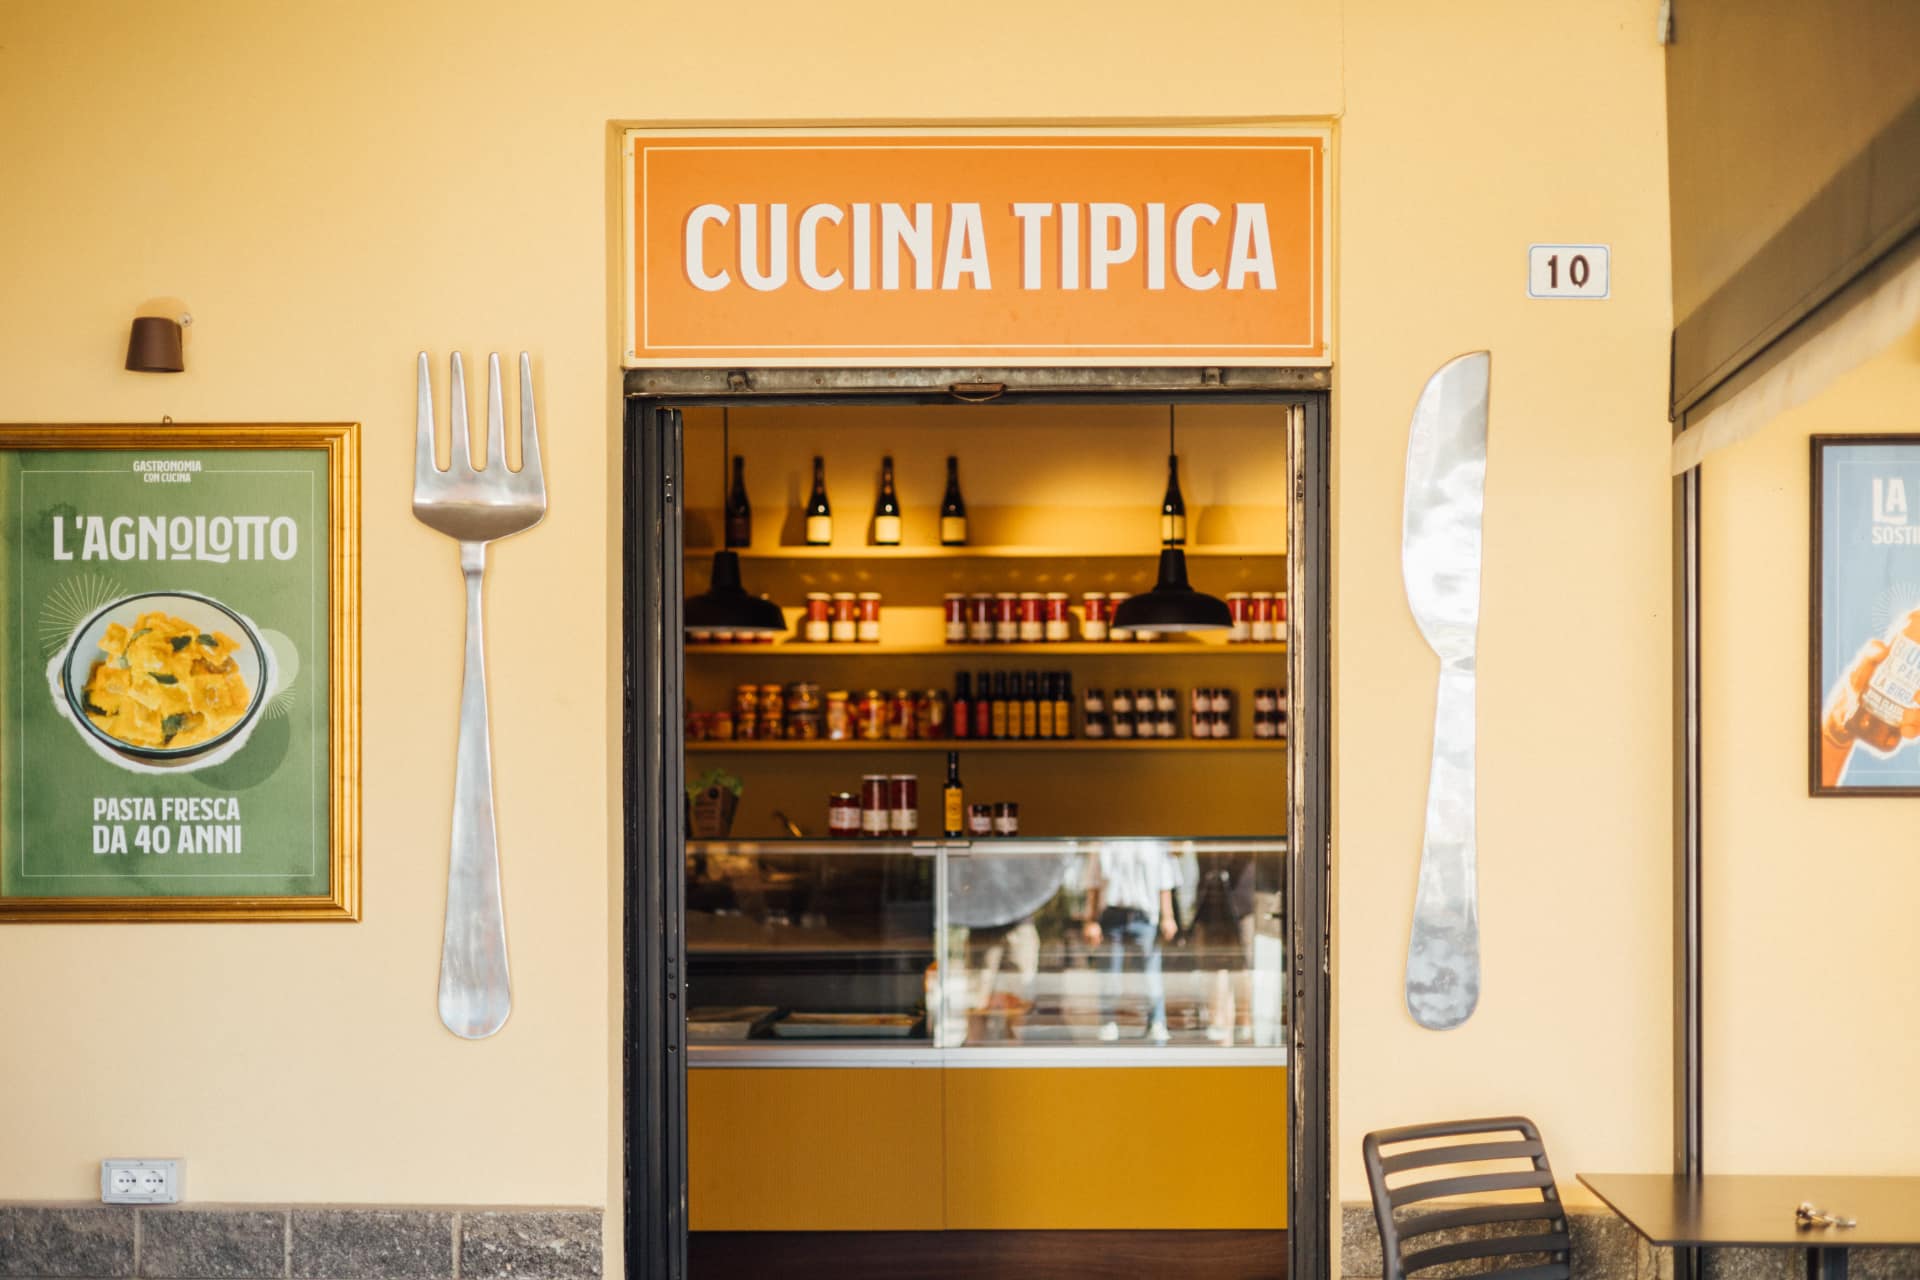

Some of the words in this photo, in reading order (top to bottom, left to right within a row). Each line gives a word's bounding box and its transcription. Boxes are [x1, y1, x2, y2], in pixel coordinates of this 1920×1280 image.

[684, 202, 992, 292] CUCINA
[1011, 202, 1277, 292] TIPICA
[1547, 253, 1590, 289] 10
[132, 460, 202, 472] GASTRONOMIA
[143, 472, 160, 483] CON
[161, 472, 191, 483] CUCINA
[1872, 478, 1908, 525] LA
[53, 515, 298, 563] L'AGNOLOTTO
[93, 797, 156, 821] PASTA
[161, 797, 240, 822] FRESCA
[92, 825, 128, 854] DA
[134, 825, 171, 854] 40
[177, 825, 241, 854] ANNI
